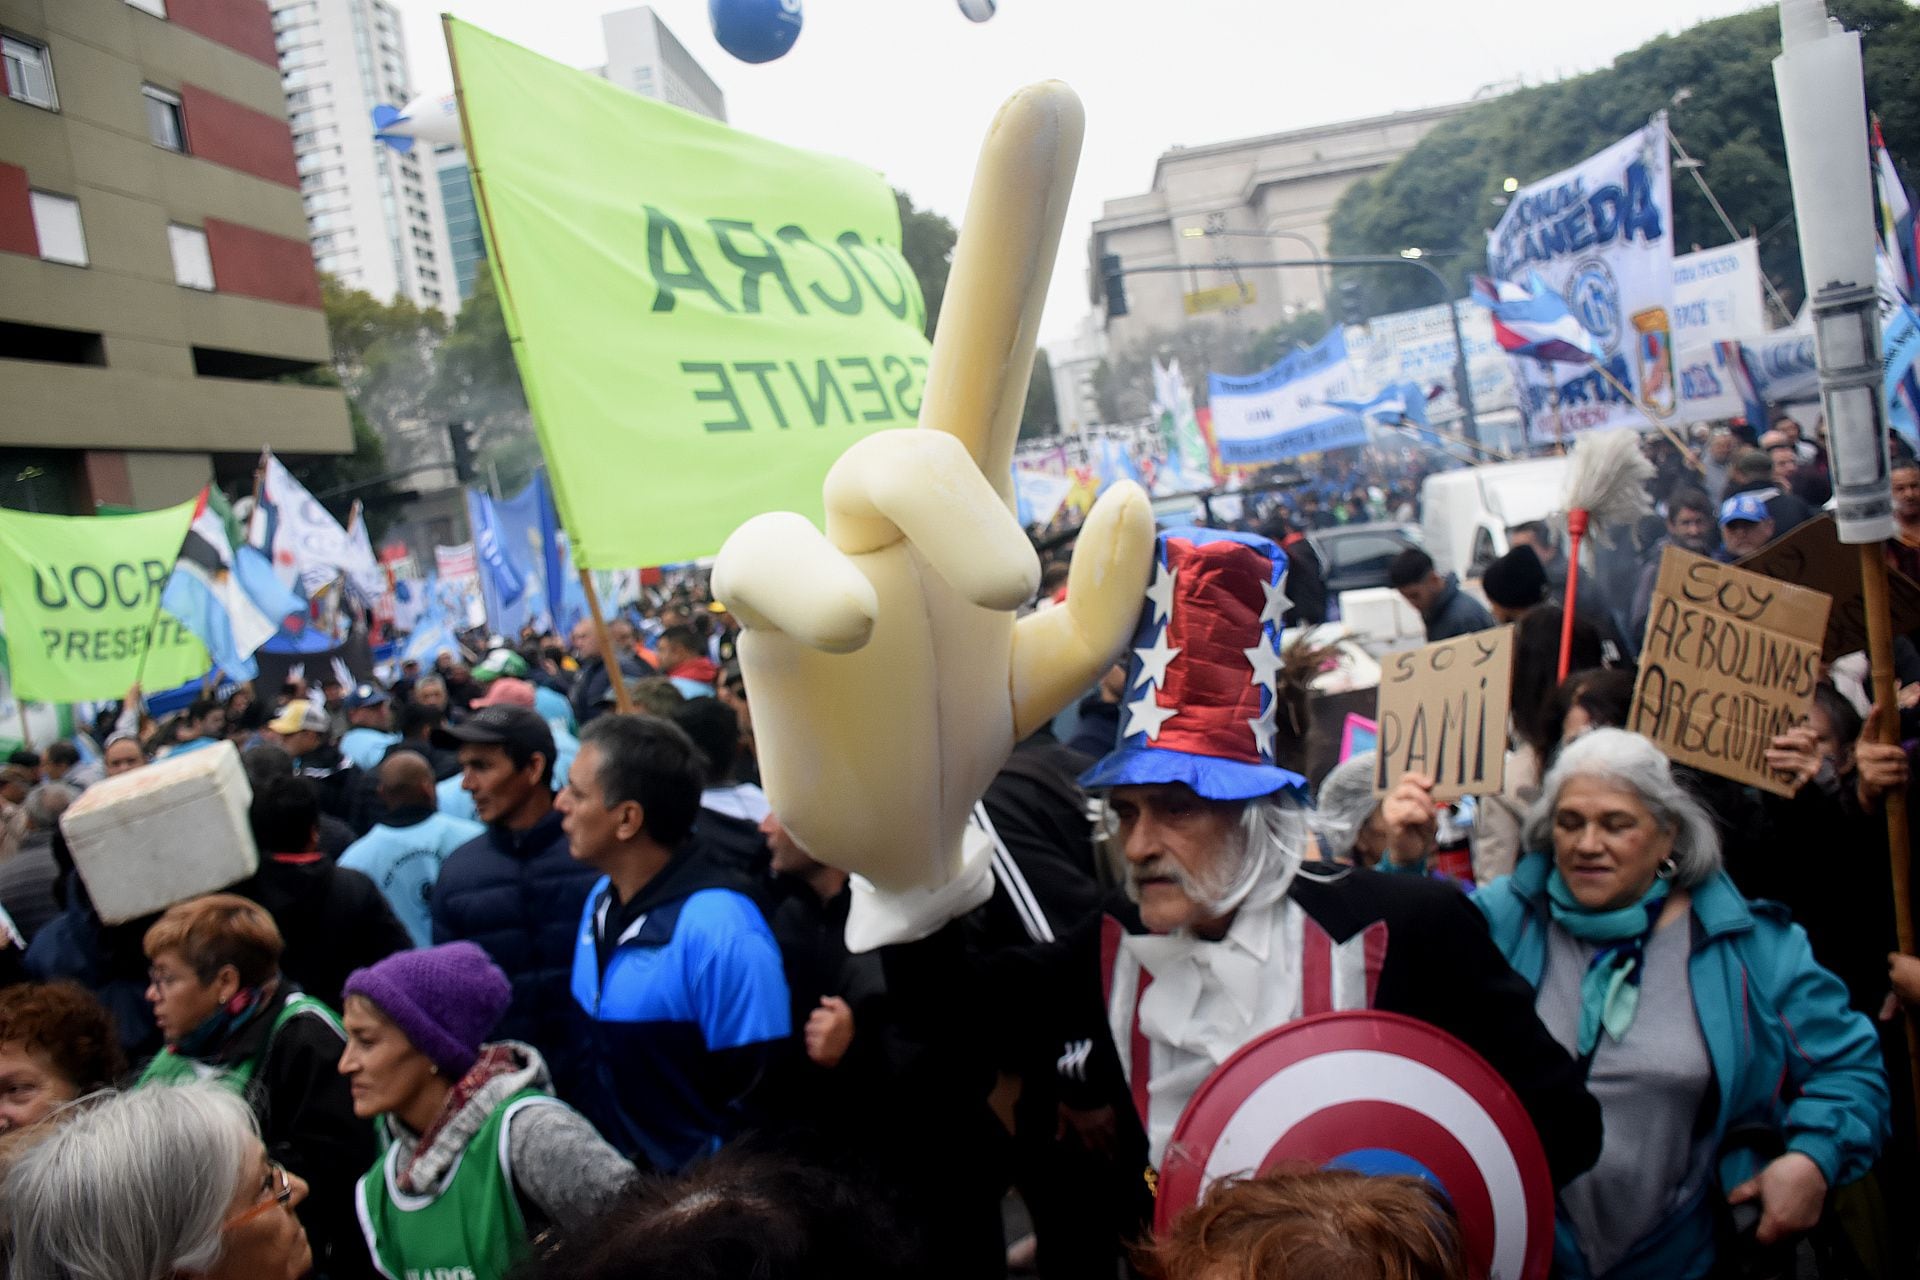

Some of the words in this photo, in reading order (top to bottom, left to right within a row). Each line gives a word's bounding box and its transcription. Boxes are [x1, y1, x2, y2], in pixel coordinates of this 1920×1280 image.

[1682, 561, 1775, 621] SOY
[42, 618, 190, 661] PRESETE
[1392, 640, 1499, 683] SOY
